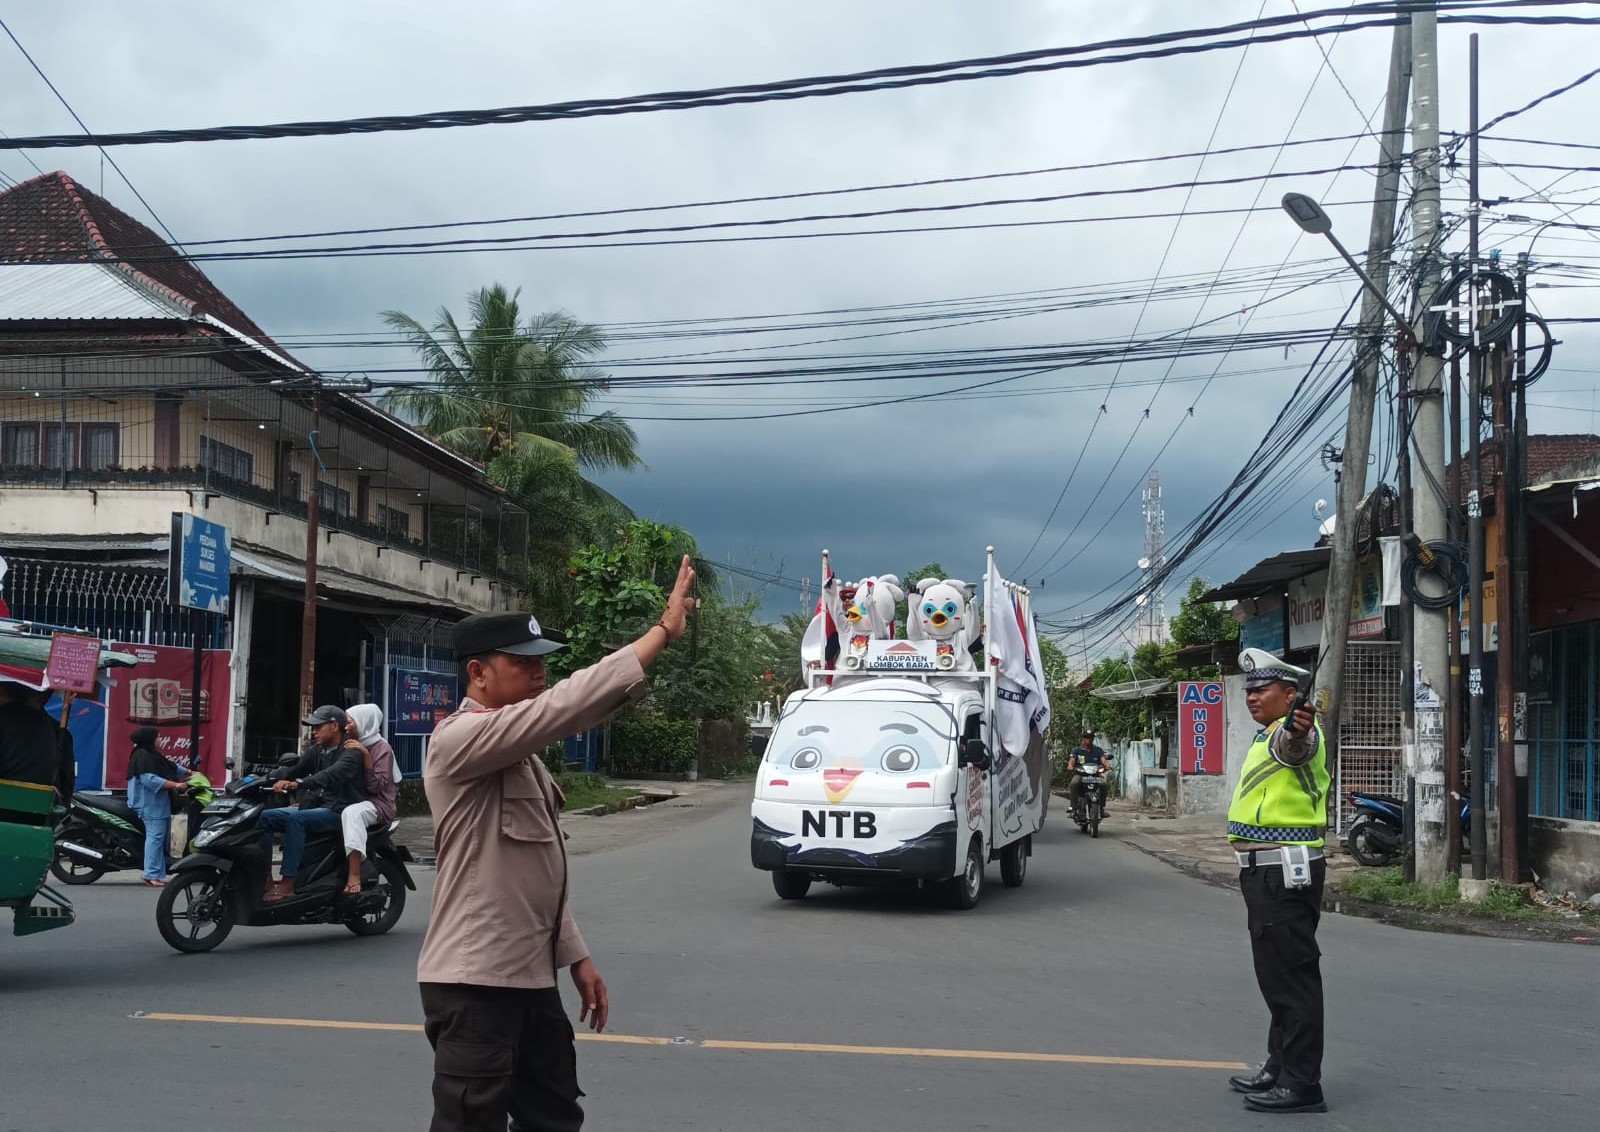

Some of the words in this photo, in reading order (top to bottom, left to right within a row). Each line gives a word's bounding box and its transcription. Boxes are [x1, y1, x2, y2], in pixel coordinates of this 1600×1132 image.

[876, 654, 928, 662] KABUPATEN
[1181, 683, 1222, 705] AC
[1192, 708, 1208, 775] MOBIL
[801, 809, 877, 839] NTB
